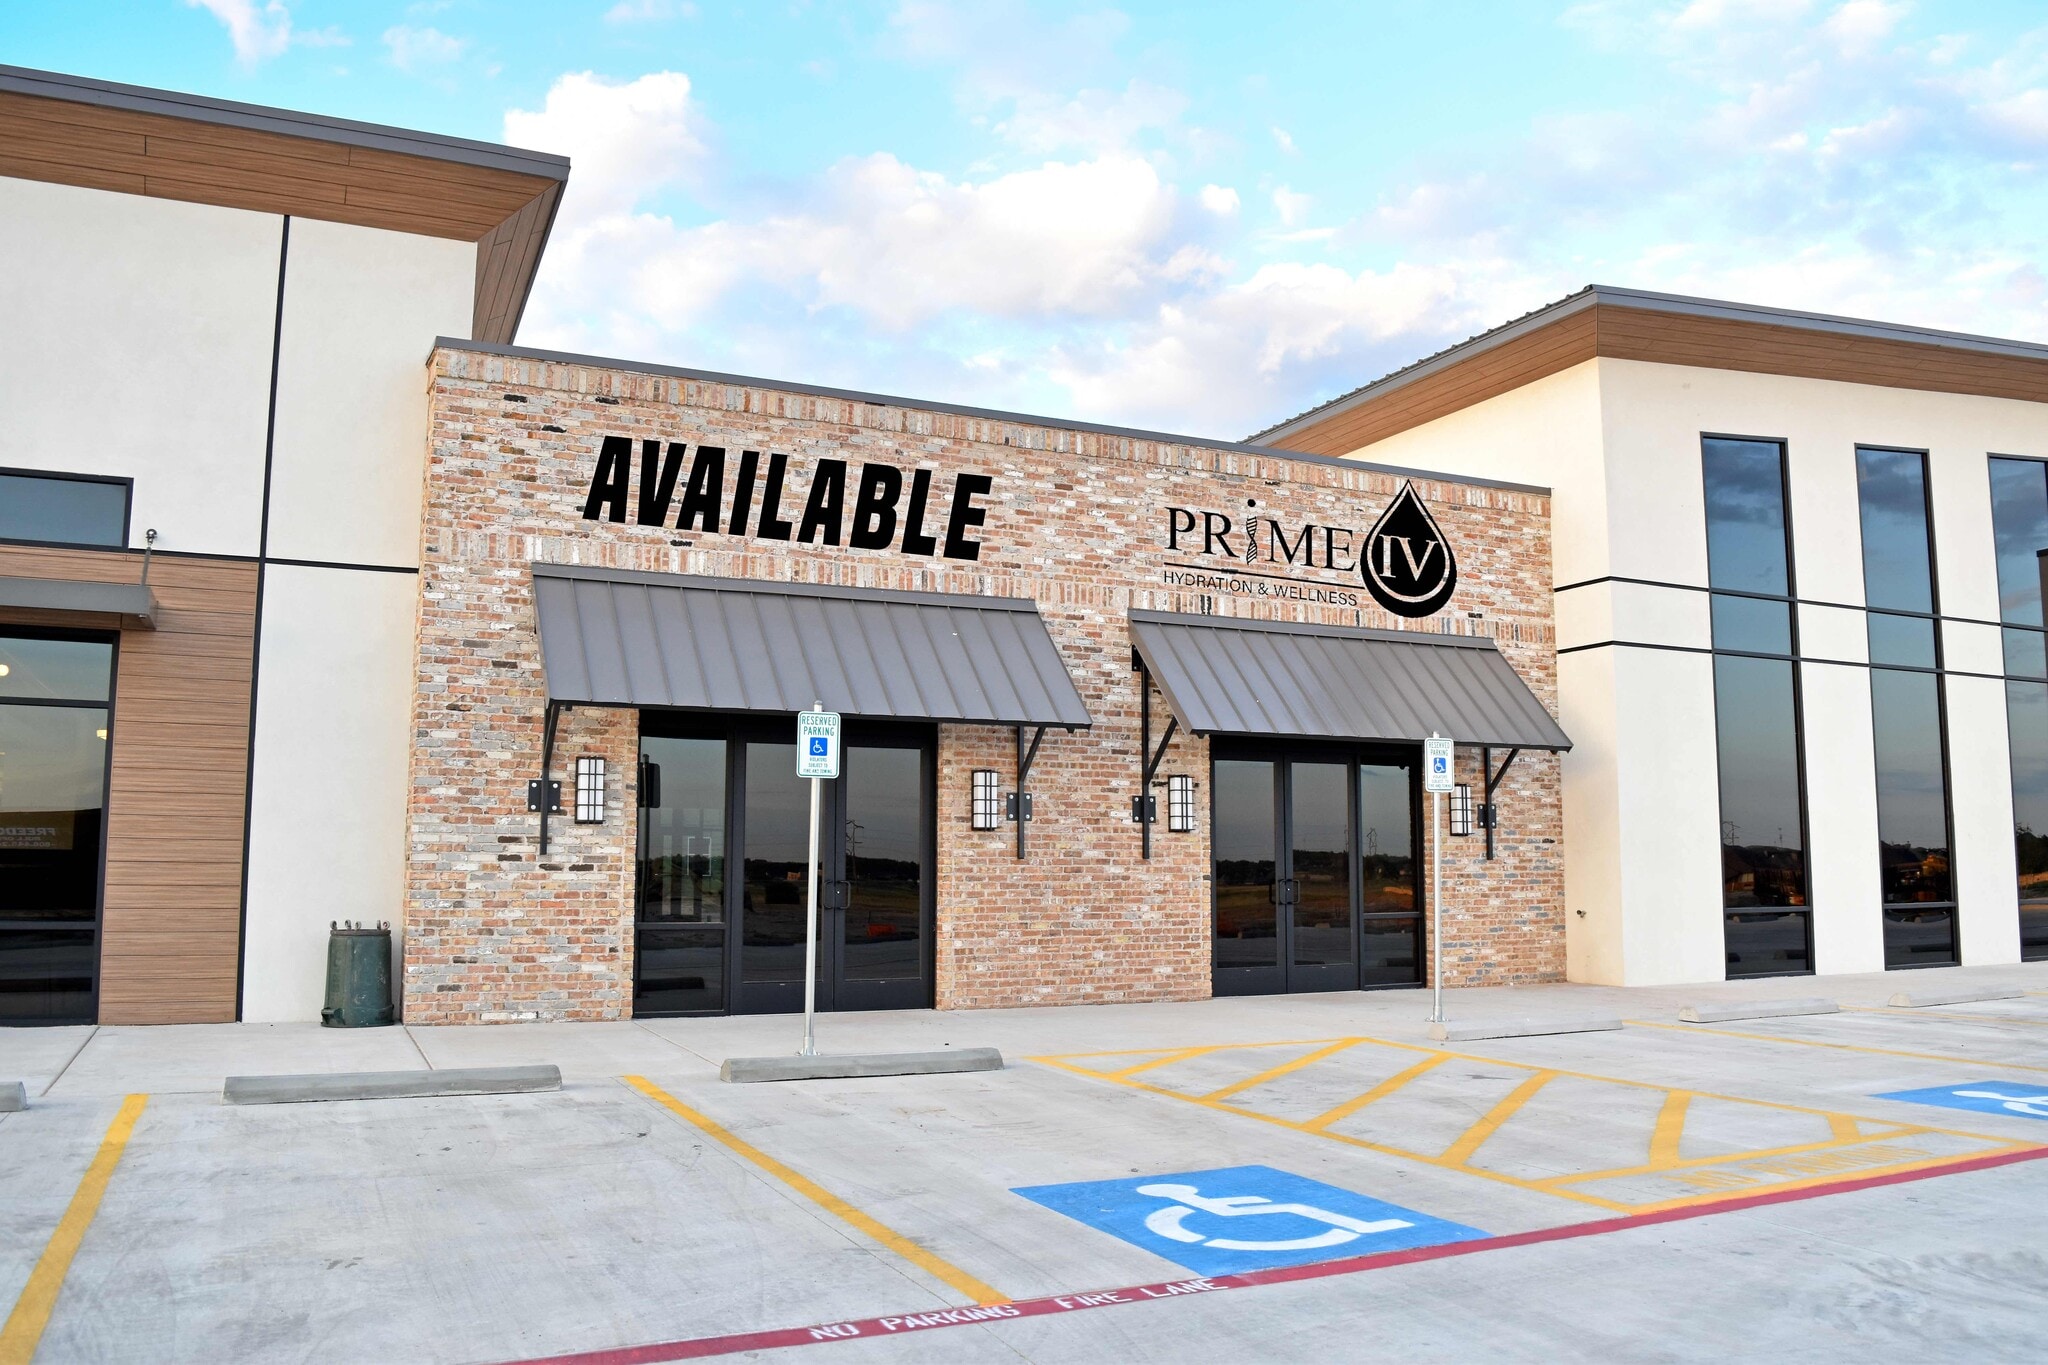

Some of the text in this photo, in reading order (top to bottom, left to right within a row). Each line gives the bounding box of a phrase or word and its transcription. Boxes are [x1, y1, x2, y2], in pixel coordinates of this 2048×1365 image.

[582, 435, 993, 561] AVAILABLE
[1379, 534, 1439, 582] IV
[1163, 571, 1358, 607] HYDRATION & WELLNESS
[801, 715, 837, 726] RESERVED
[803, 726, 835, 736] PARKING
[1428, 741, 1450, 749] RESERVED
[810, 1278, 1229, 1340] NO PARKING FIRE LANE
